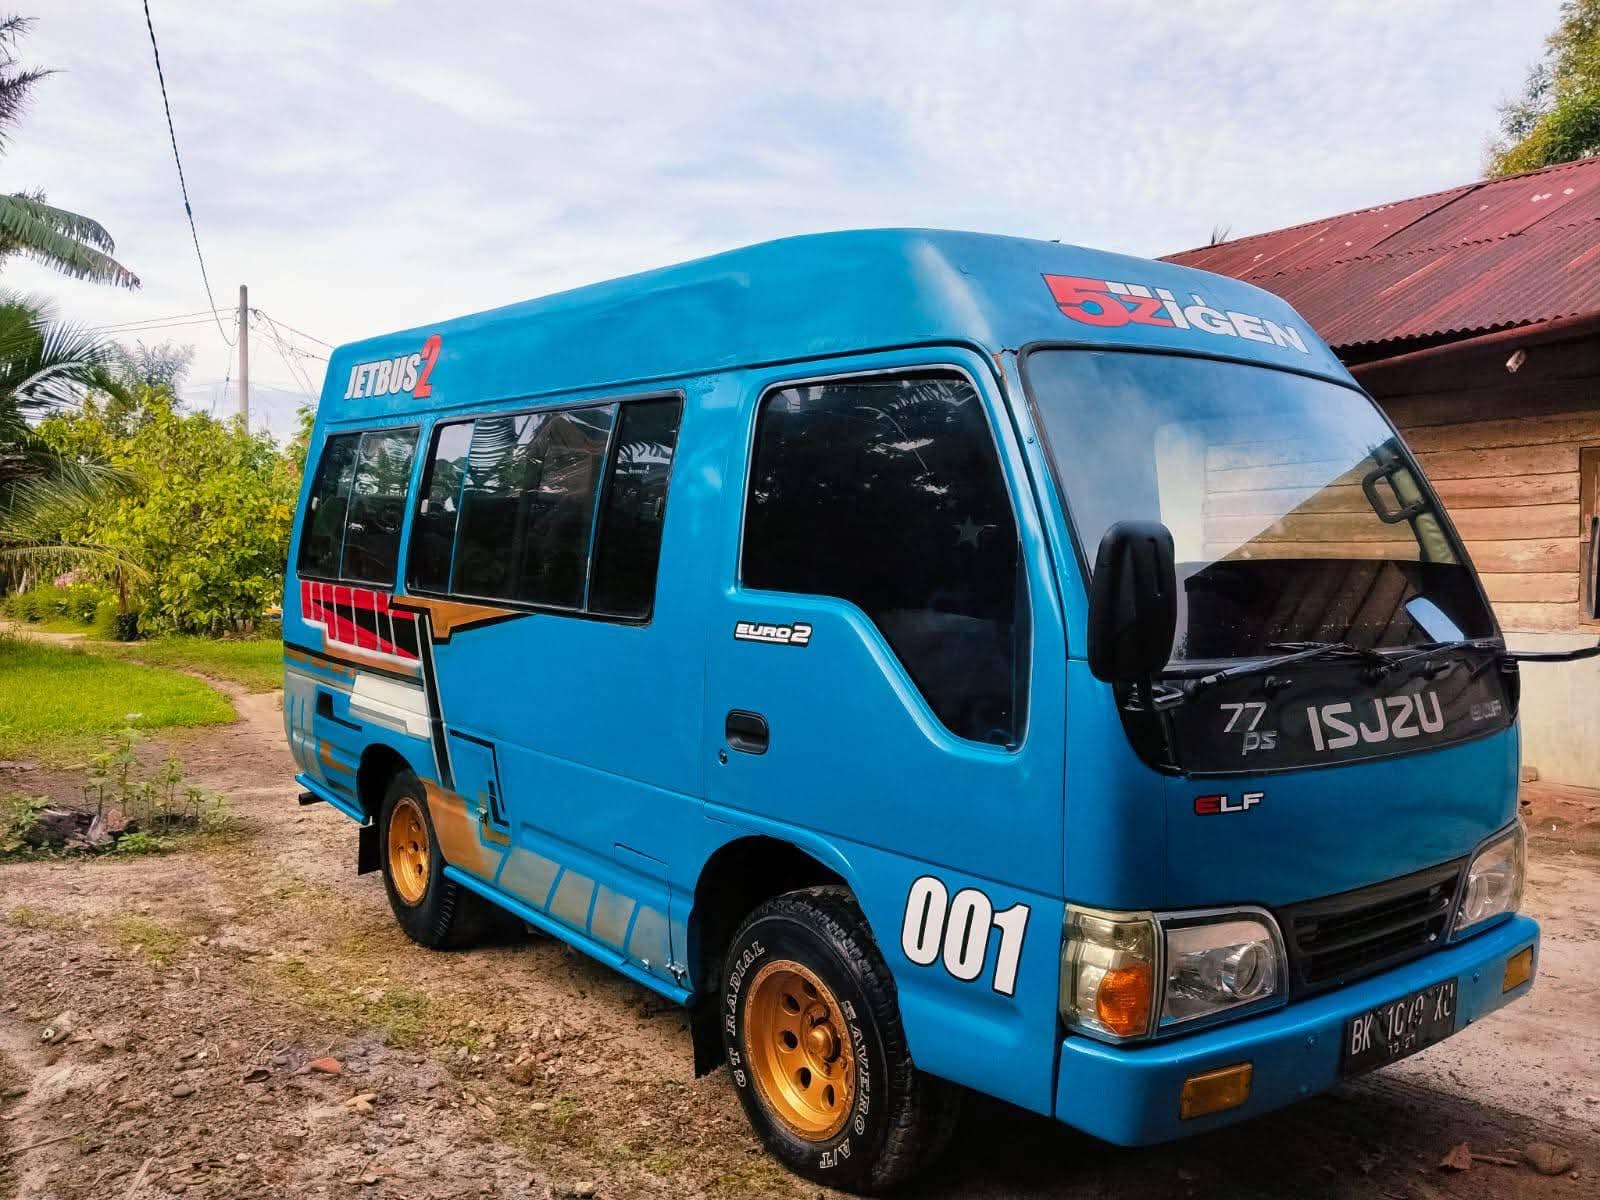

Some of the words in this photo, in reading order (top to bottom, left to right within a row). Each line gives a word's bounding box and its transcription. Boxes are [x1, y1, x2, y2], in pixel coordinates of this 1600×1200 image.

[1220, 702, 1267, 733] 77
[1195, 792, 1265, 815] ELF
[902, 874, 1031, 998] 001
[726, 940, 765, 1037] RADIAL
[1351, 1012, 1375, 1055] BK
[728, 1047, 747, 1088] GT
[841, 999, 871, 1136] SAVERO
[819, 1137, 851, 1169] A/T
